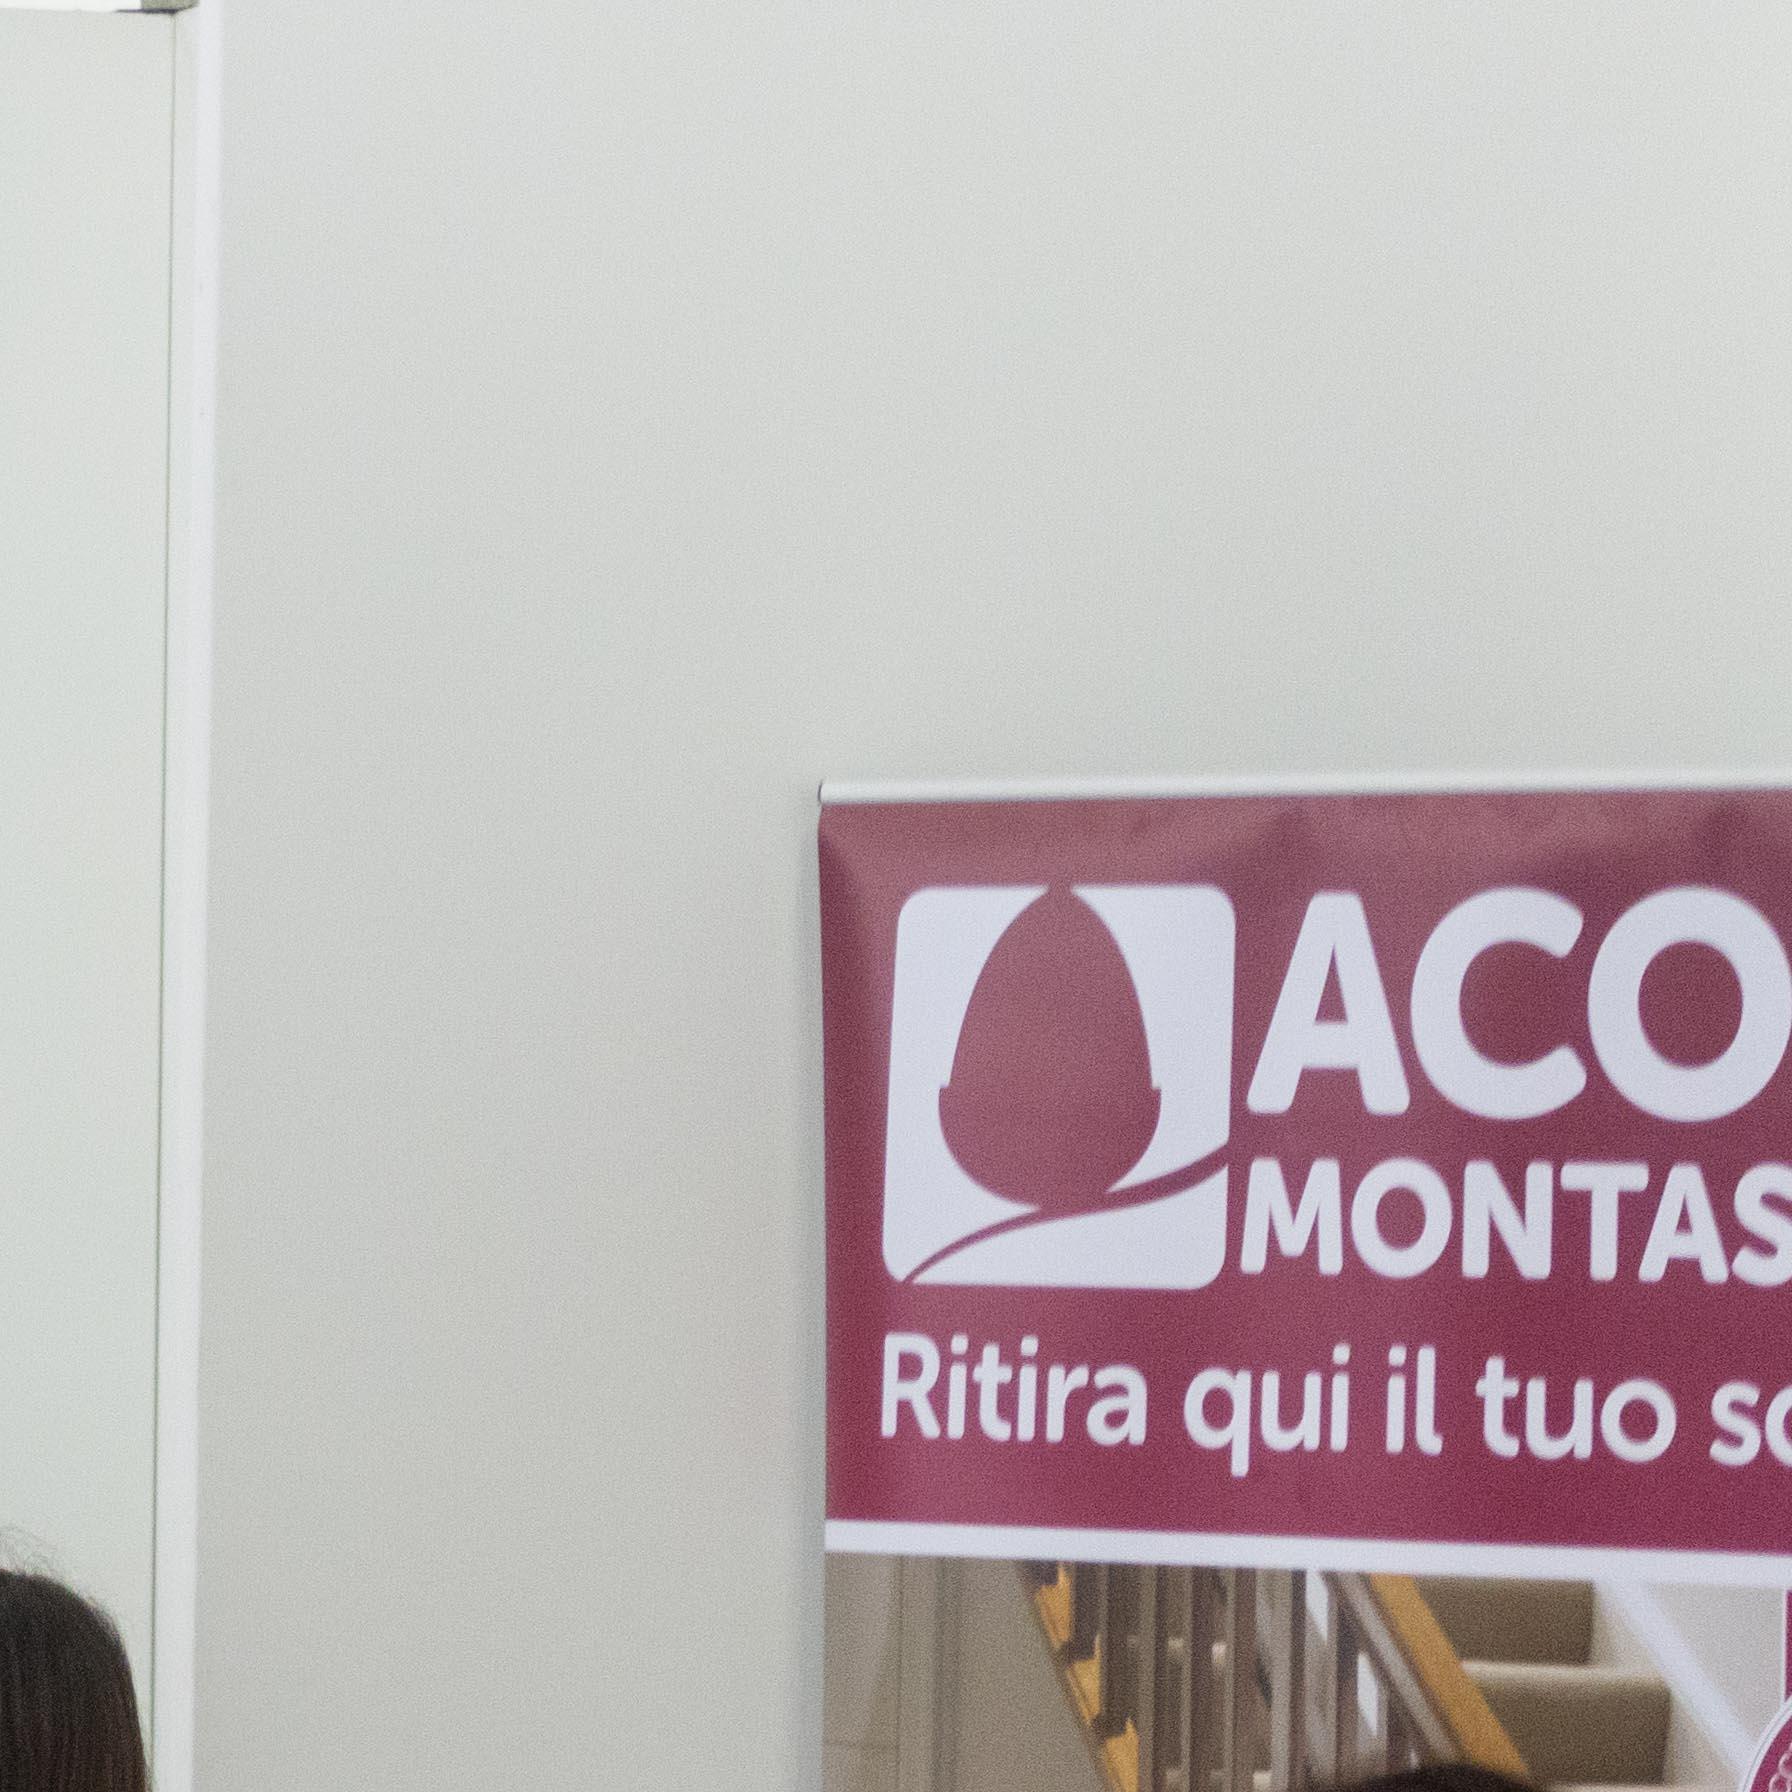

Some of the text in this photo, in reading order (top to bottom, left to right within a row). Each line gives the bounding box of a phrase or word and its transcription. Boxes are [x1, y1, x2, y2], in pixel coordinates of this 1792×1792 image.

[1247, 887, 1792, 1121] ACO
[1241, 1158, 1792, 1285] MONTAS
[882, 1333, 1147, 1445] Ritira
[1184, 1344, 1350, 1476] qui
[1387, 1346, 1442, 1454] il
[1476, 1357, 1676, 1461] tuo
